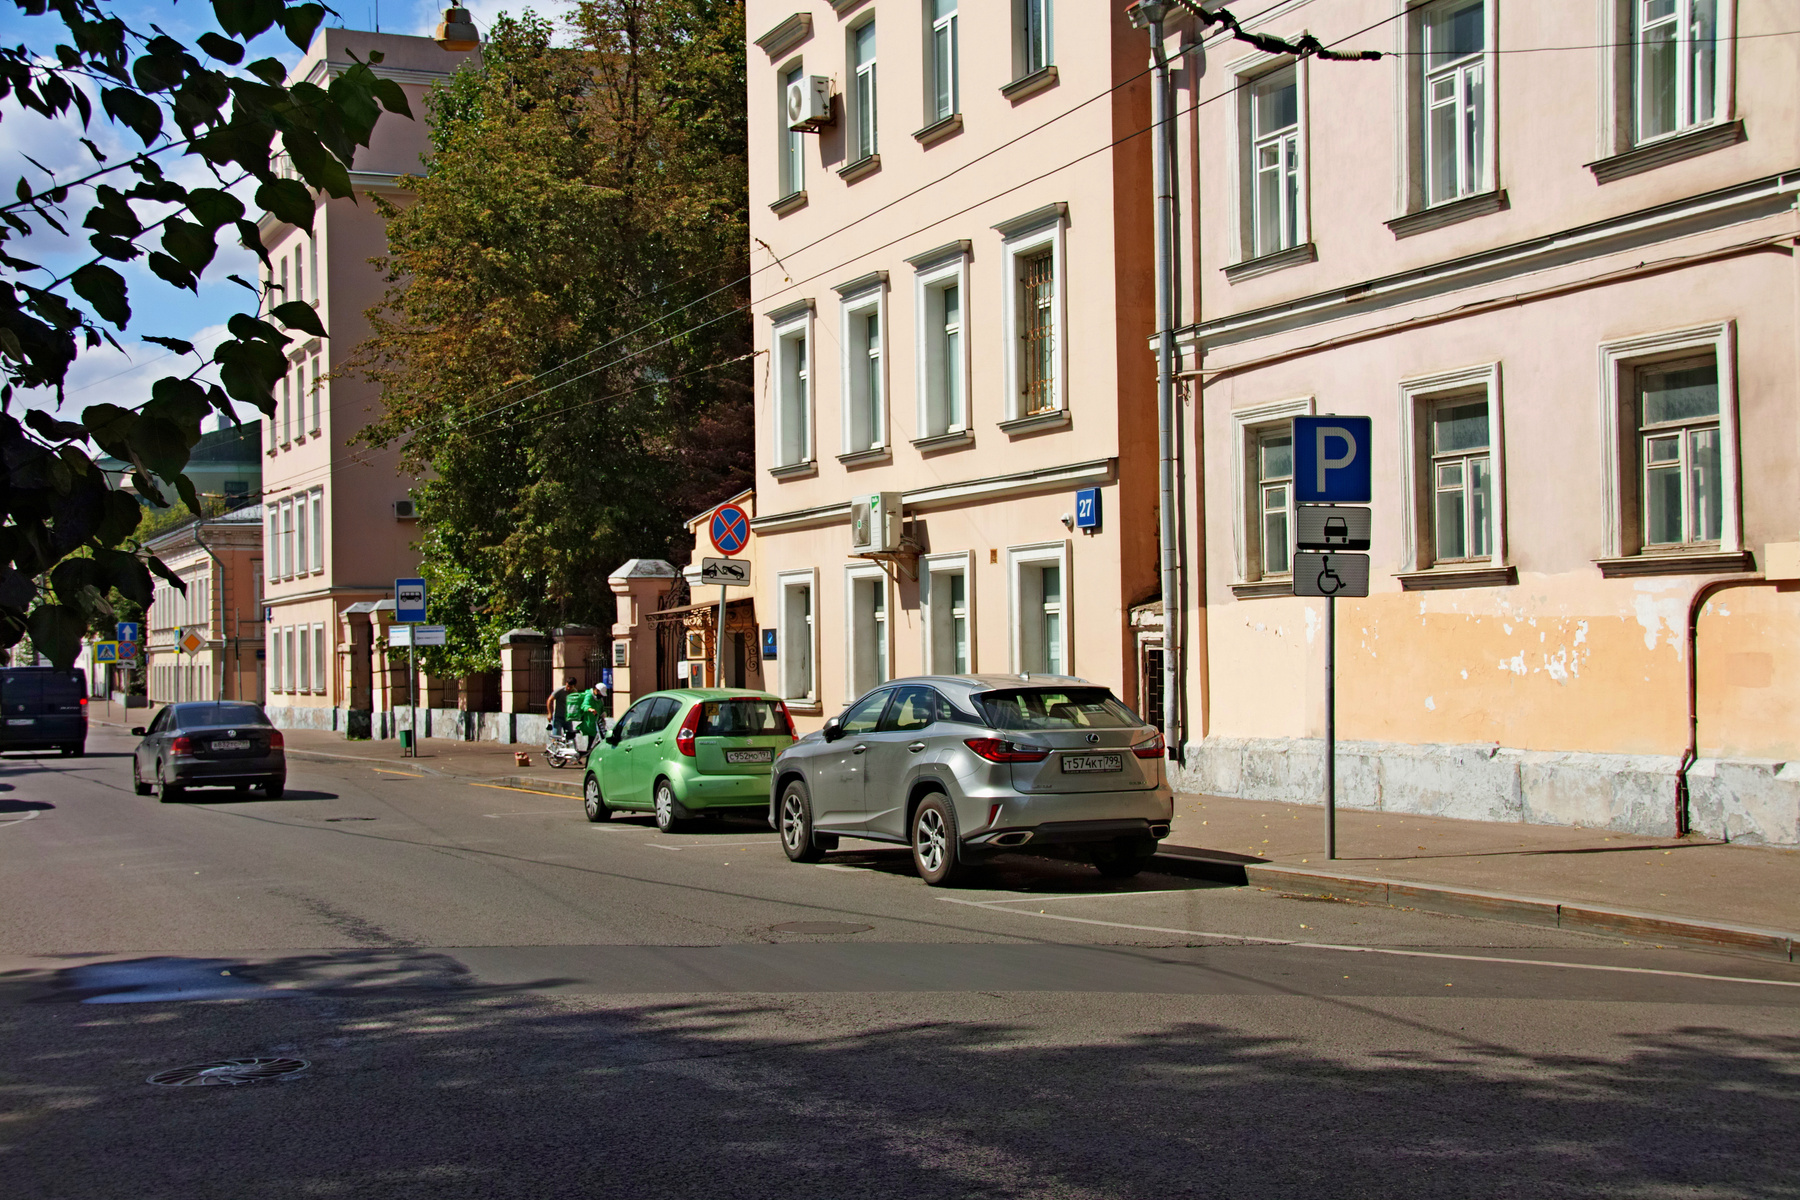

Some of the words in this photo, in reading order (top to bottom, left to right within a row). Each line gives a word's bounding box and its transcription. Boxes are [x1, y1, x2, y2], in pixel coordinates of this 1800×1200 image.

[1316, 426, 1357, 493] P
[1079, 499, 1092, 518] 27
[1066, 757, 1103, 769] Т574КТ
[1104, 756, 1119, 765] 799
